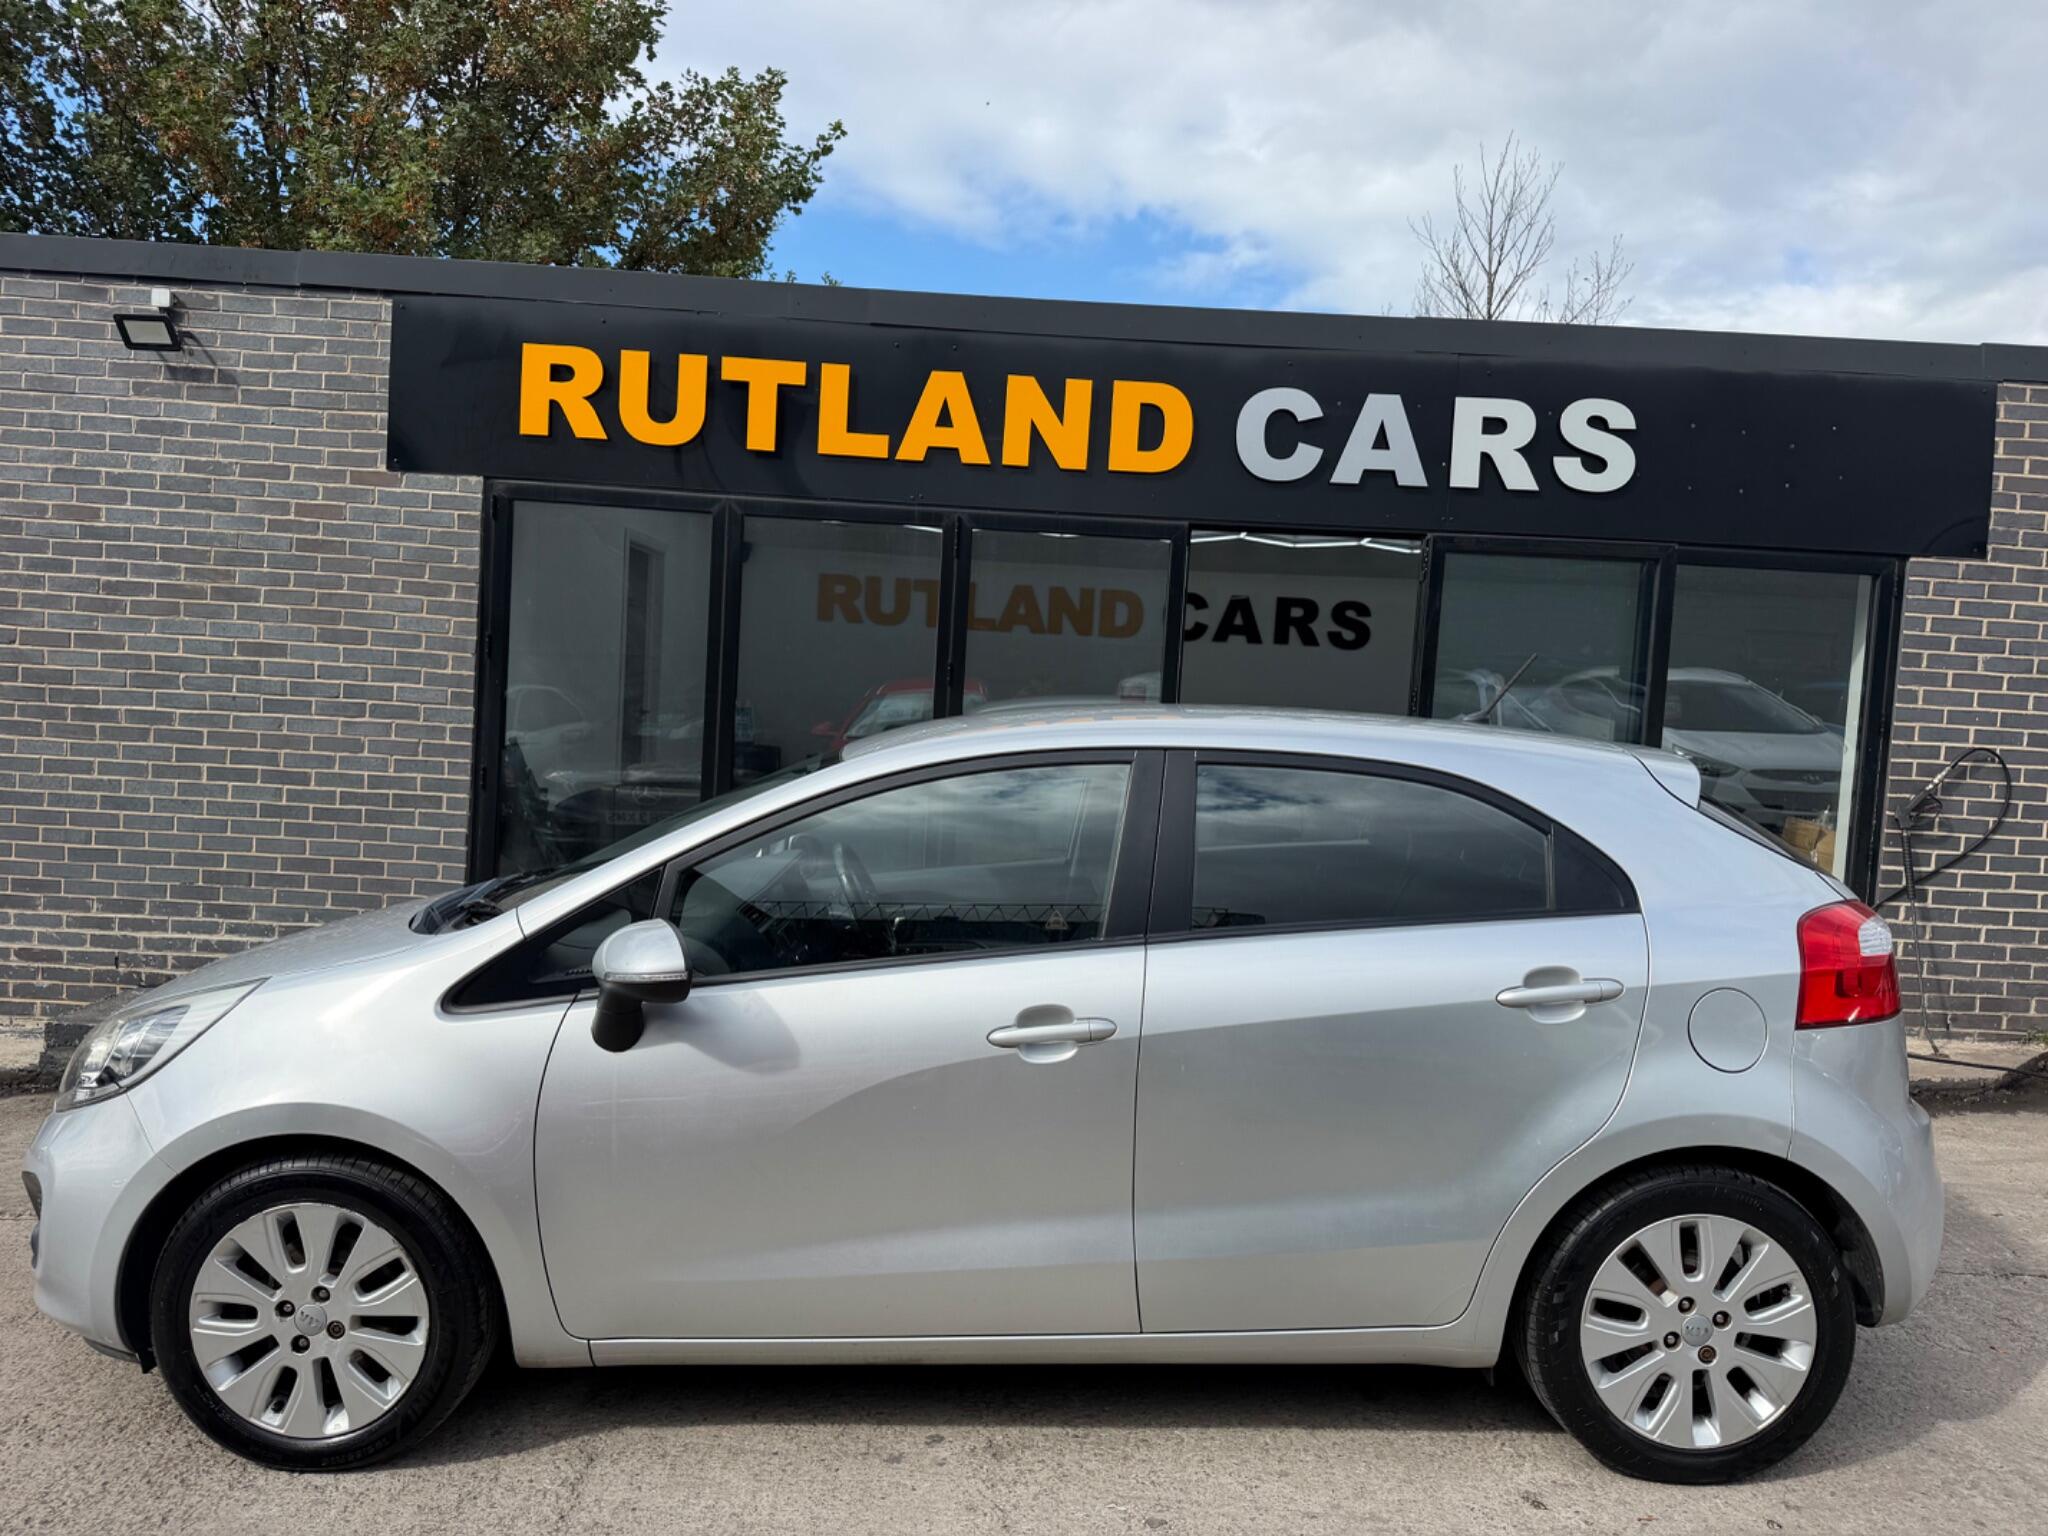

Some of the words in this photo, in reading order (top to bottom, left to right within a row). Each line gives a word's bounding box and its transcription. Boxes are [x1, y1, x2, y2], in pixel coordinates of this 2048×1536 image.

[519, 342, 1195, 474] RUTLAND
[1235, 387, 1637, 494] CARS
[817, 573, 1144, 638] RUTLAND
[1163, 591, 1372, 650] CARS
